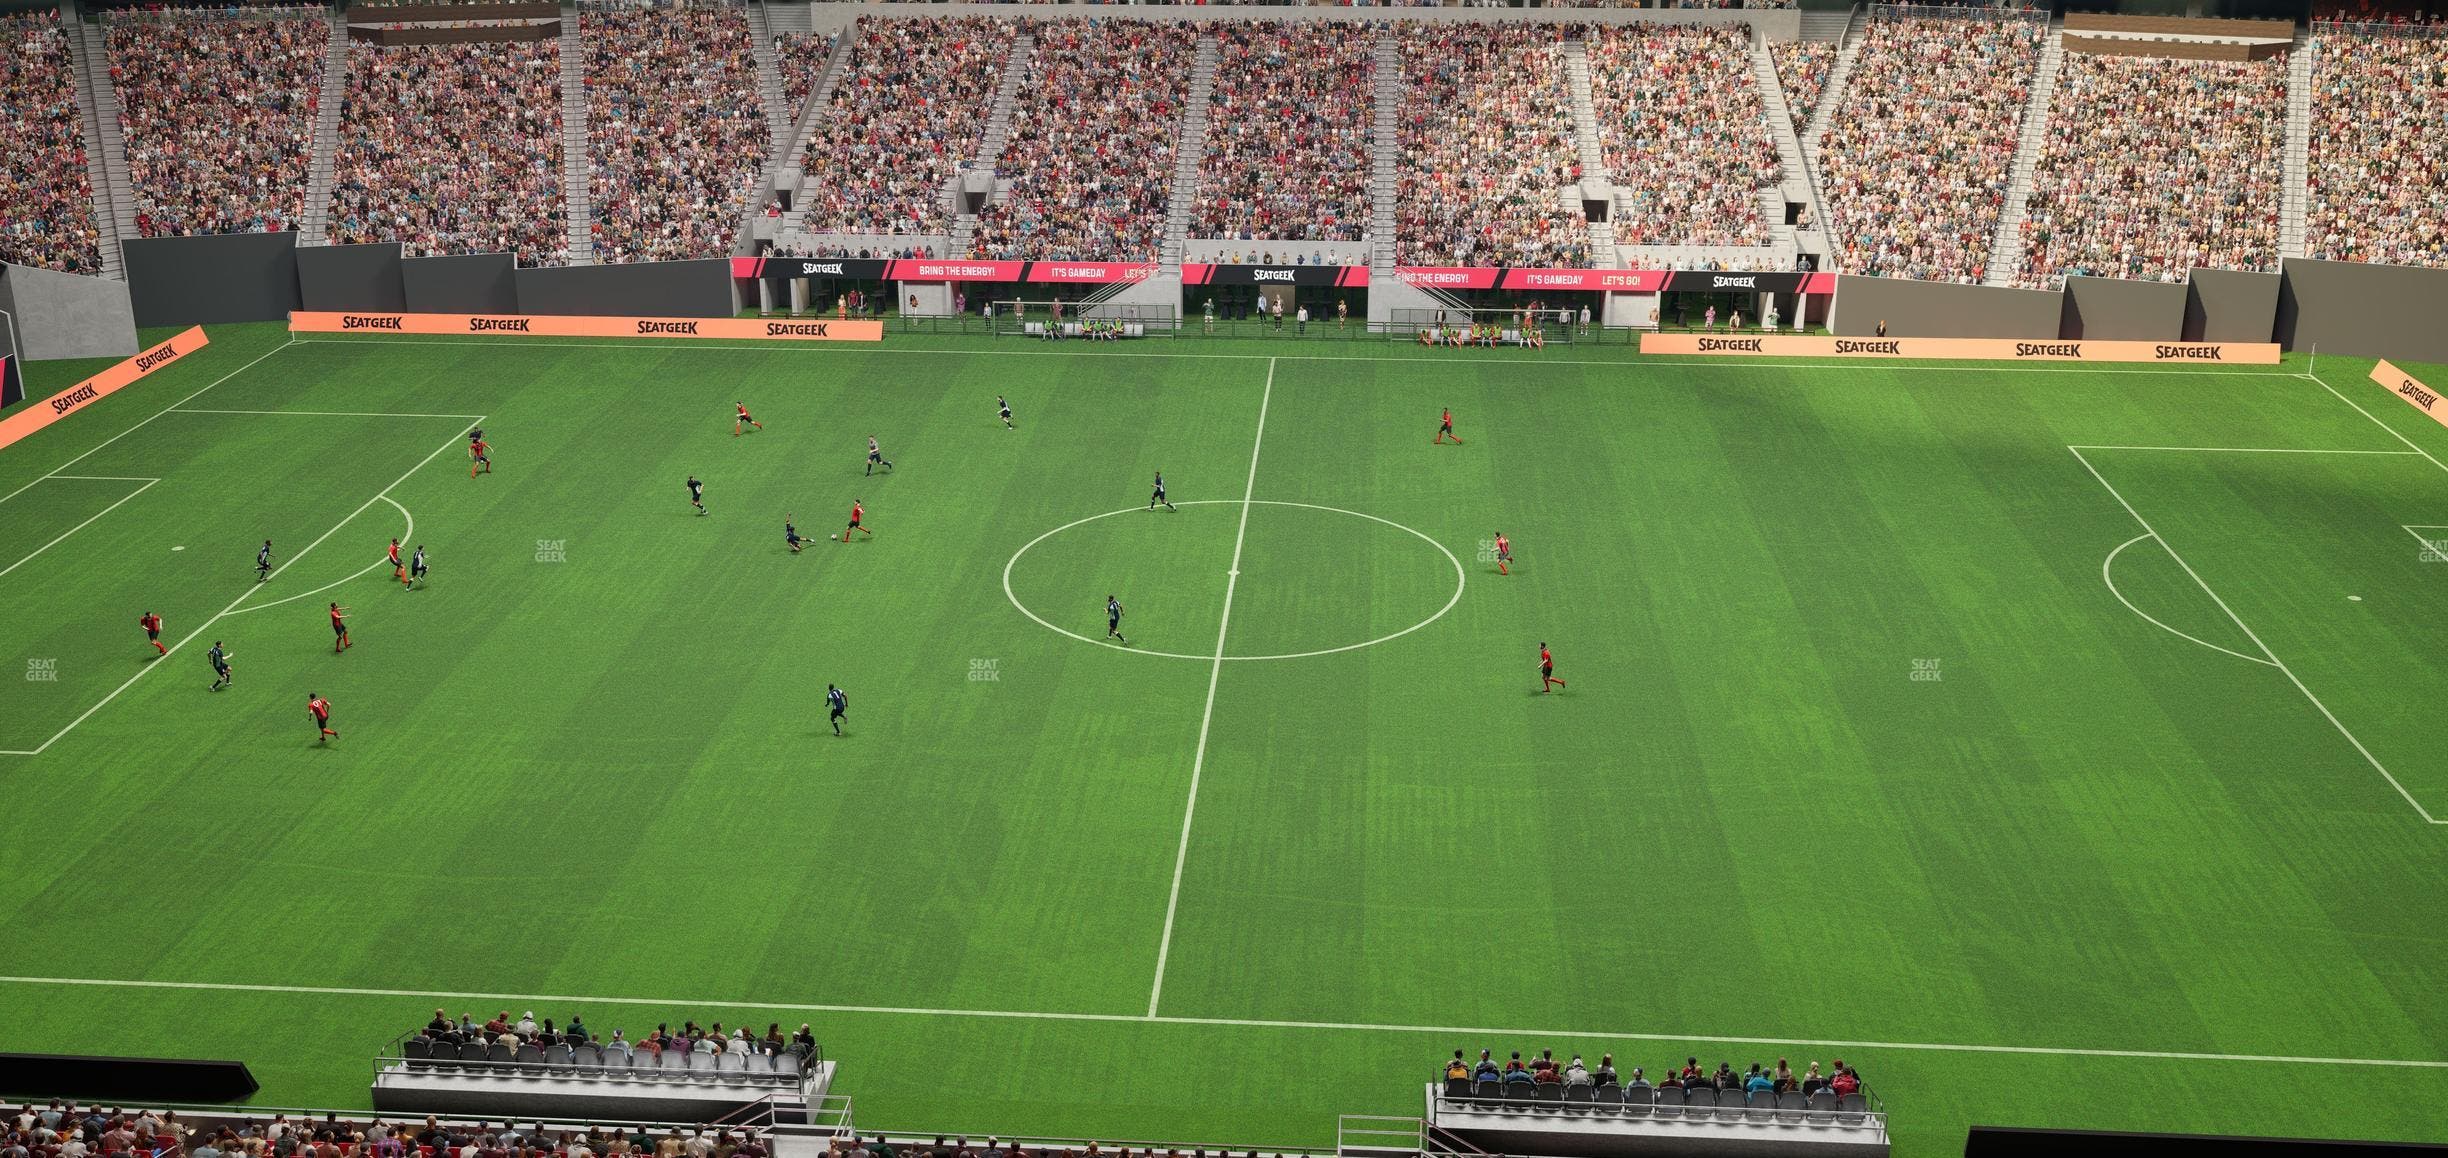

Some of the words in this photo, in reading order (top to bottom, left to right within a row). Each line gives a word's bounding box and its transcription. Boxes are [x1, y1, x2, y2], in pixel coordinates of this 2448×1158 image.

[803, 262, 843, 275] SEATGEEK
[919, 265, 944, 276] BRING
[945, 265, 961, 276] THE
[962, 266, 996, 277] ENERGY!
[1051, 267, 1068, 278] IT'S
[1069, 267, 1106, 278] GAMEDAY
[1254, 269, 1296, 282] SEATGEEK
[1434, 273, 1469, 284] ENERGY!
[1527, 274, 1543, 285] IT'S
[1544, 274, 1583, 285] GAMEDAY
[1602, 275, 1622, 286] LET'S
[1623, 275, 1641, 286] GO!
[1713, 276, 1756, 289] SEATGEEK
[343, 316, 403, 330] SEATGEEK
[470, 318, 530, 332] SEATGEEK
[637, 320, 698, 334] SEATGEEK
[767, 322, 828, 337] SEATGEEK
[1698, 338, 1762, 352] SEATGEEK
[1836, 341, 1900, 355] SEATGEEK
[2016, 343, 2081, 358] SEATGEEK
[136, 344, 178, 373] SEATGEEK
[2155, 346, 2221, 360] SEATGEEK
[51, 383, 99, 415] SEATGEEK
[2398, 379, 2438, 411] SEATGEEK
